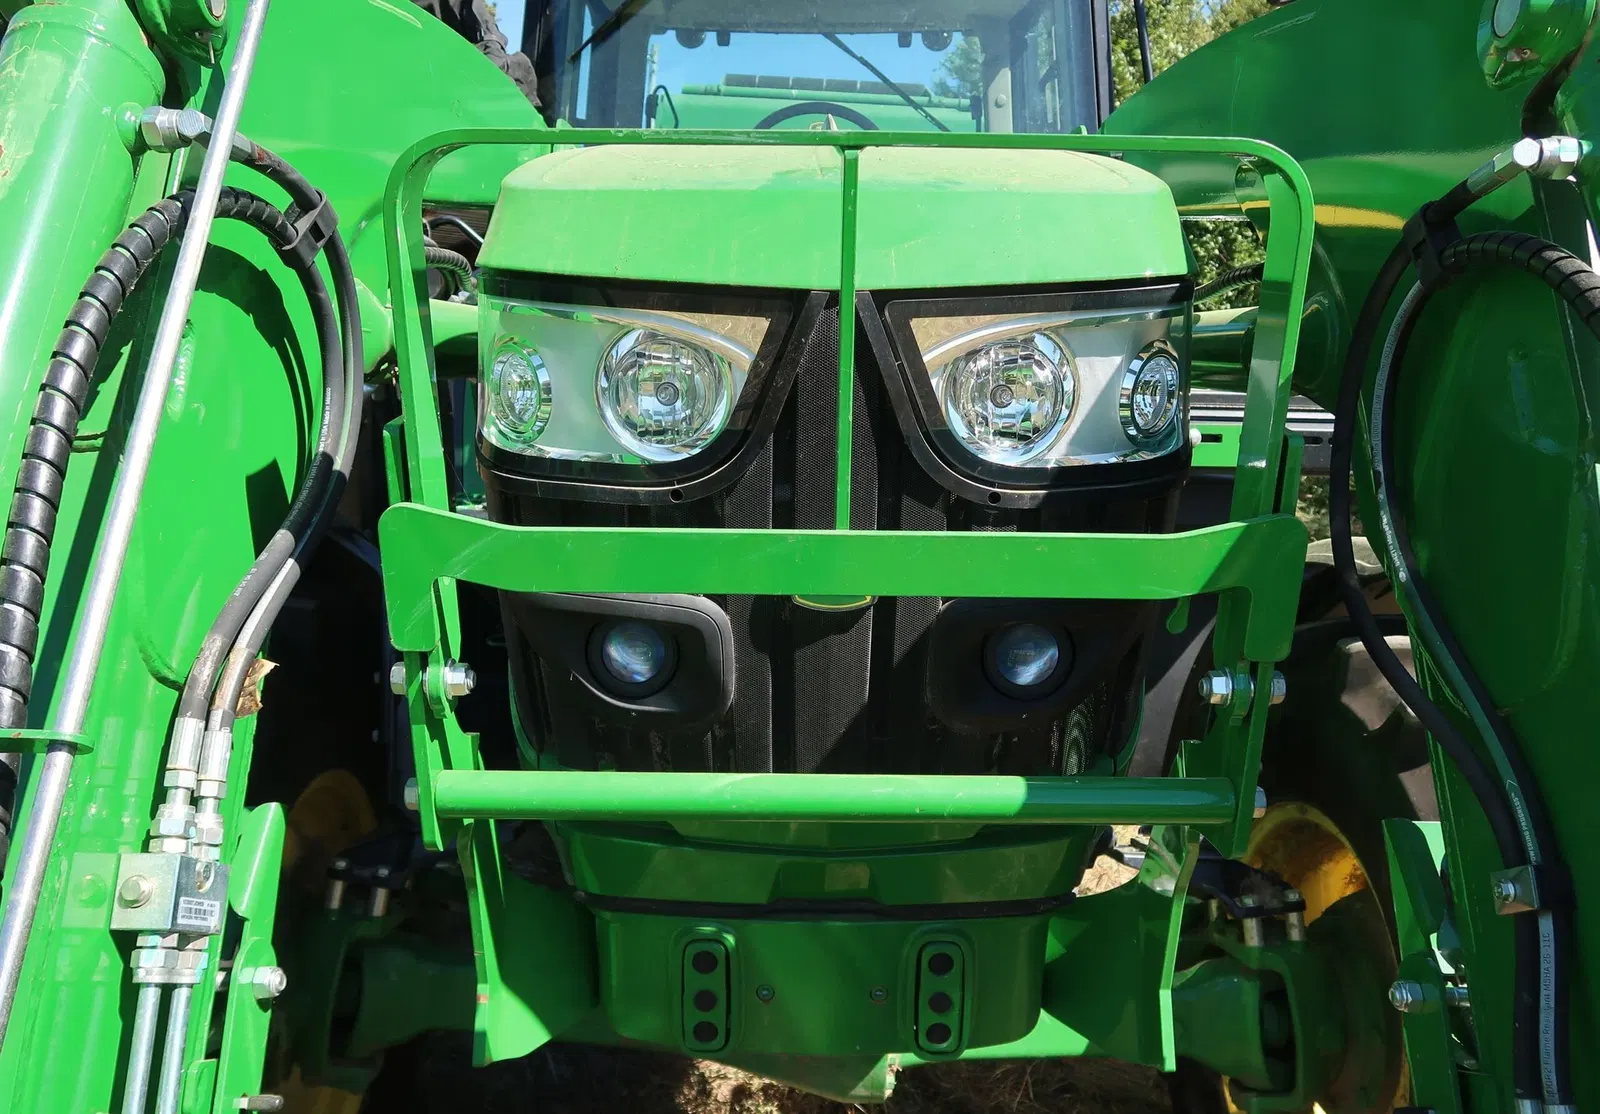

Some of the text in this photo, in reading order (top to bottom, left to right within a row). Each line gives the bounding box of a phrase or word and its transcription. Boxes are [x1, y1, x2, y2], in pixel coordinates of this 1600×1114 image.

[1543, 966, 1551, 991] MSHA
[1543, 993, 1551, 1034] Resistant
[1543, 1036, 1551, 1065] Flame
